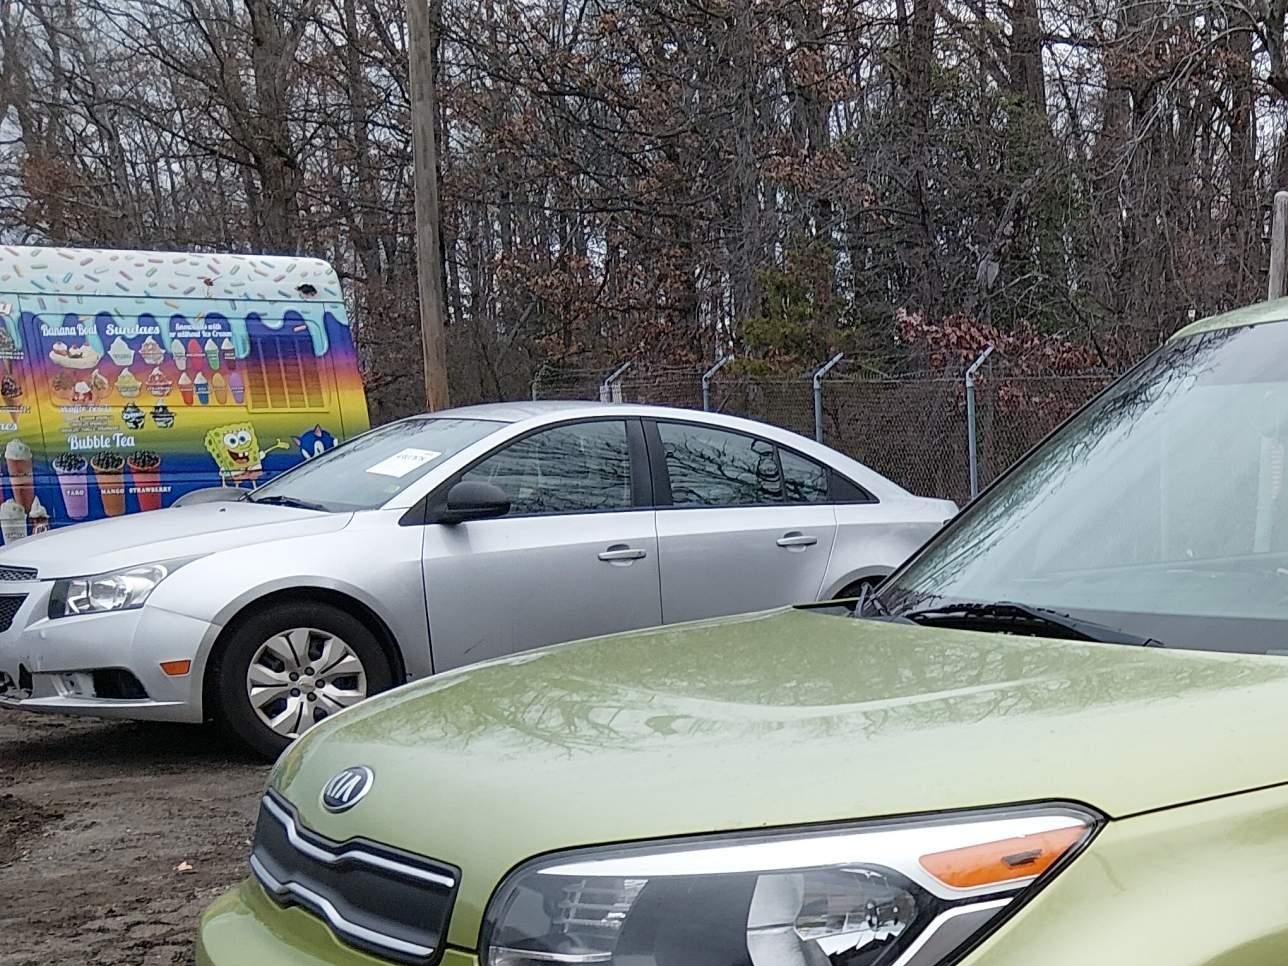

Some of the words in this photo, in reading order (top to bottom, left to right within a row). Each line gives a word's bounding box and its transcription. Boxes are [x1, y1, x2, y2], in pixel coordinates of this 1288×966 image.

[41, 324, 76, 336] Banana
[77, 323, 97, 336] Boat
[106, 324, 160, 335] Sundaes
[208, 323, 222, 331] with
[212, 330, 233, 338] Cream
[68, 433, 111, 450] Bubble
[112, 432, 135, 447] Tea
[129, 486, 172, 494] STRAWBERRY
